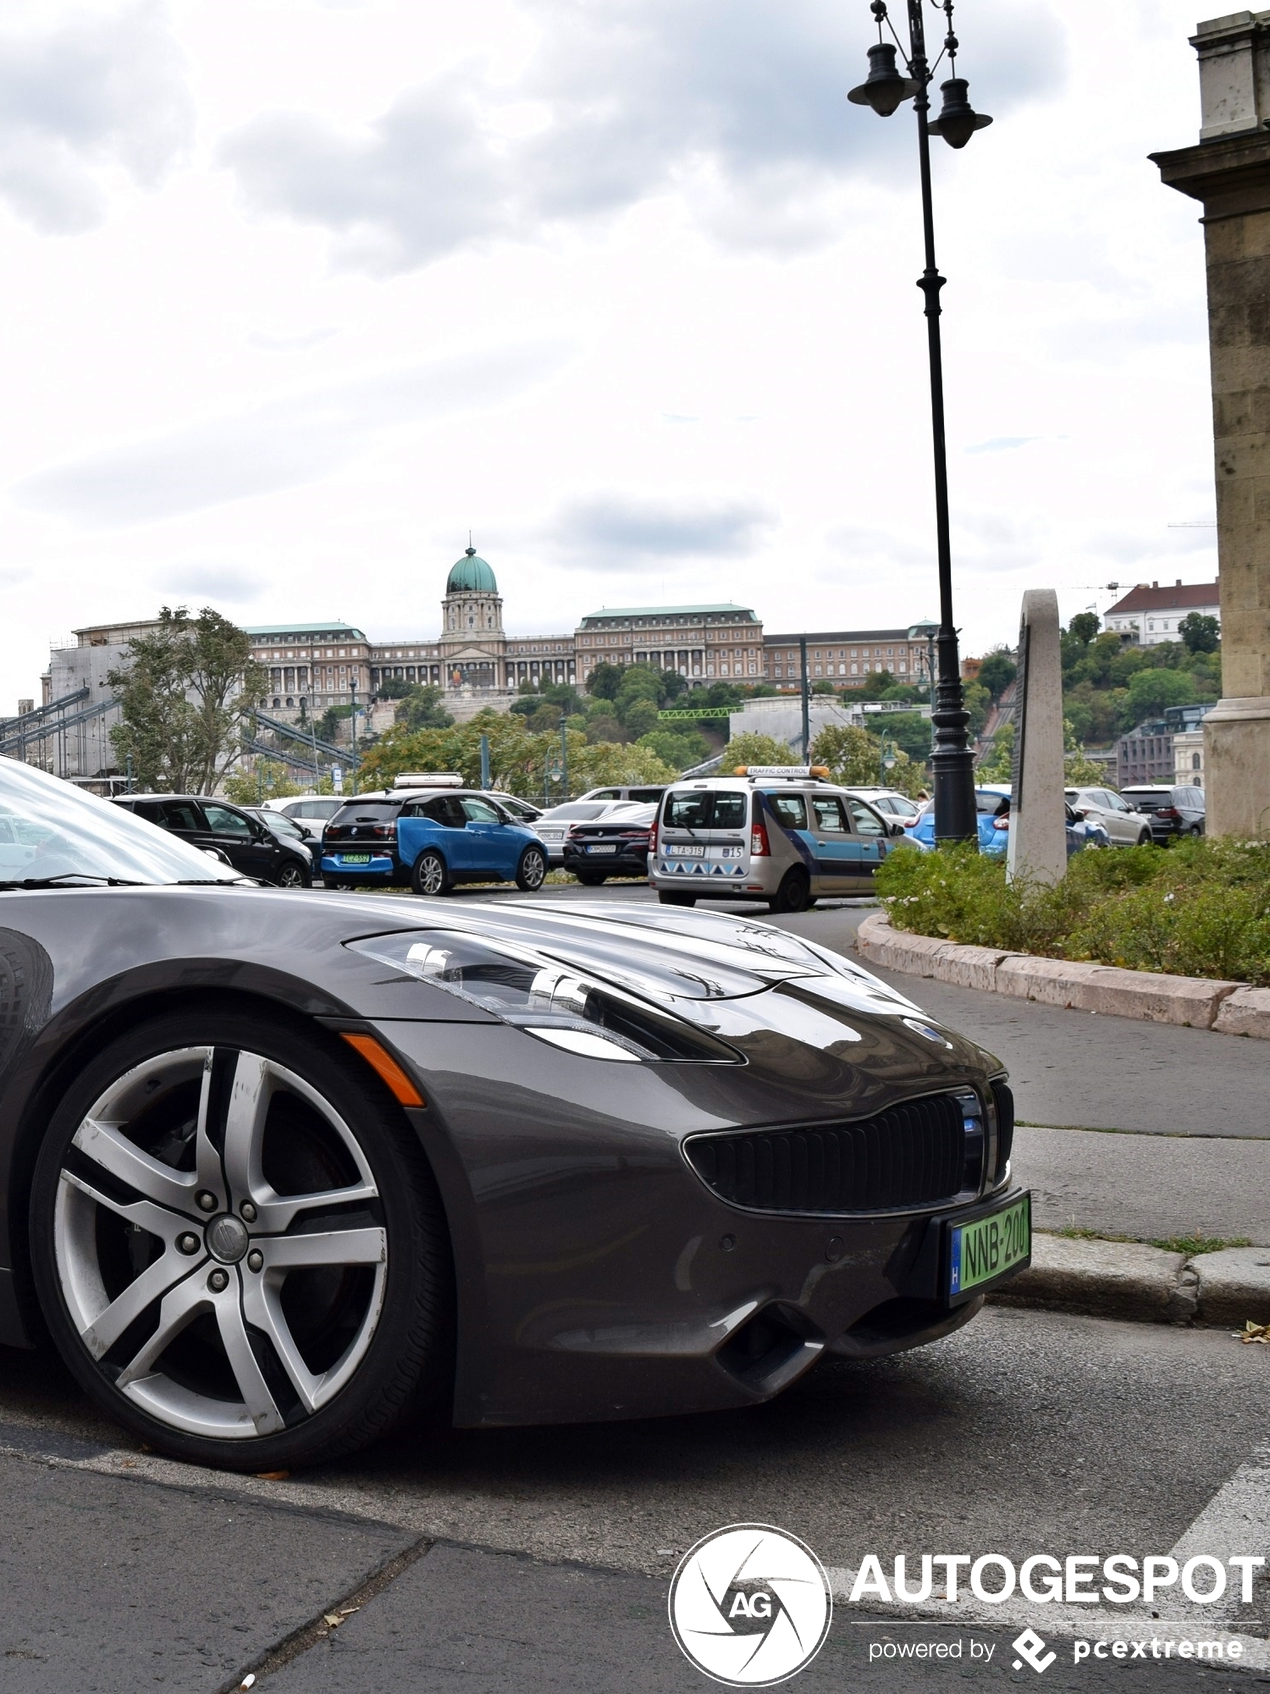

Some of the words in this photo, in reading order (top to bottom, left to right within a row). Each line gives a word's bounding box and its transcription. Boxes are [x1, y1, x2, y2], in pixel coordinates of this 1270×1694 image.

[671, 846, 702, 855] LTA-315
[730, 847, 742, 857] 15
[964, 1207, 1026, 1282] NNB-200
[951, 1266, 959, 1285] H
